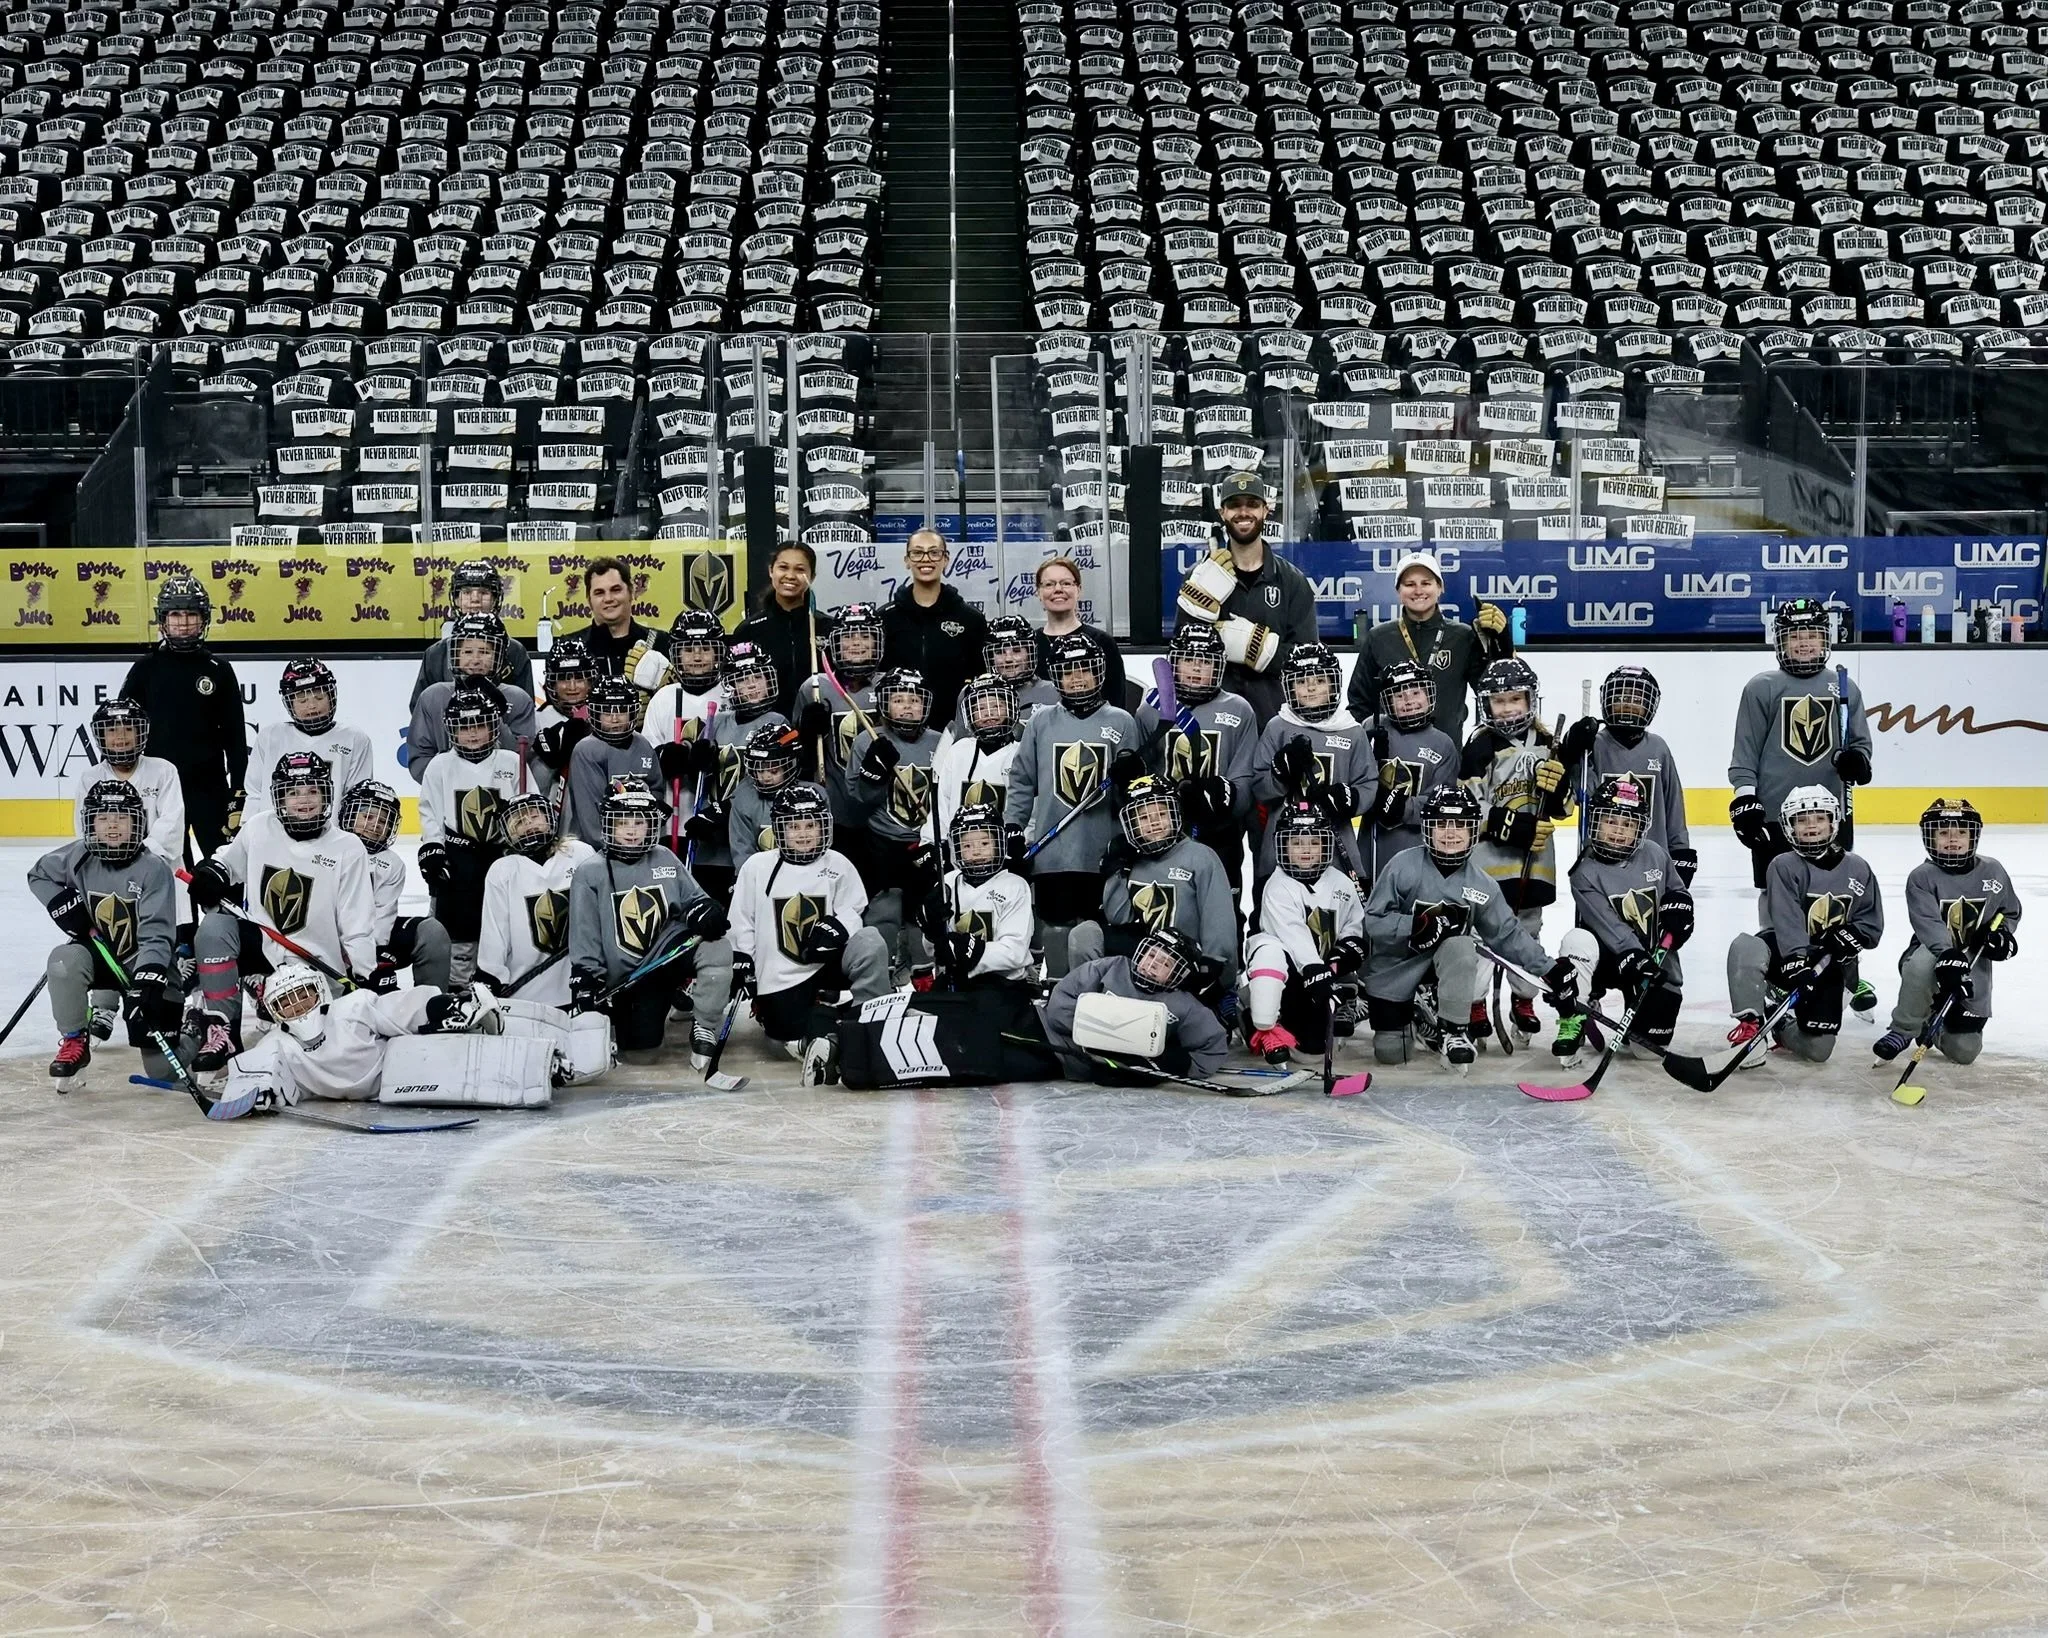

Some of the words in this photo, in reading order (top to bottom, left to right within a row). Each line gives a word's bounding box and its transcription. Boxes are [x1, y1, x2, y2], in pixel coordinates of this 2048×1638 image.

[377, 411, 399, 423] NEVER
[457, 412, 480, 424] NEVER
[545, 409, 567, 421] NEVER
[1313, 405, 1335, 417] NEVER
[1396, 405, 1418, 417] NEVER
[1411, 448, 1433, 462] NEVER
[1493, 449, 1516, 462] NEVER
[356, 487, 381, 501] NEVER
[445, 485, 469, 497] NEVER
[1345, 486, 1369, 499] NEVER
[1602, 481, 1626, 496] NEVER
[1358, 525, 1382, 539] NEVER
[1439, 526, 1463, 540] NEVER
[1631, 519, 1654, 533] NEVER
[324, 531, 344, 545] EVER
[345, 532, 378, 545] RETREAT.
[859, 547, 875, 558] LAS
[967, 546, 984, 557] LAS
[1568, 546, 1654, 571] UMC
[1761, 544, 1849, 570] UMC
[1953, 543, 2040, 568] UMC
[279, 558, 328, 578] Booster
[346, 557, 396, 578] Booster
[827, 548, 885, 579] Vegas
[1372, 548, 1460, 573] UC
[10, 562, 58, 581] Booster
[77, 562, 126, 581] Booster
[211, 559, 261, 580] Booster
[1470, 575, 1558, 600] UMC
[1664, 574, 1751, 598] UMC
[1857, 571, 1944, 596] UMC
[14, 608, 54, 626] Juice
[81, 608, 121, 626] Juice
[216, 606, 256, 625] Juice
[283, 604, 323, 624] Juice
[351, 604, 390, 623] Juice
[1567, 602, 1654, 627] UMC
[1730, 802, 1764, 819] BAUE
[203, 956, 230, 964] CCM
[865, 995, 907, 1010] BAUER
[1609, 1007, 1636, 1052] BAUER
[1807, 1020, 1839, 1030] CCM
[394, 1084, 439, 1094] BAUER
